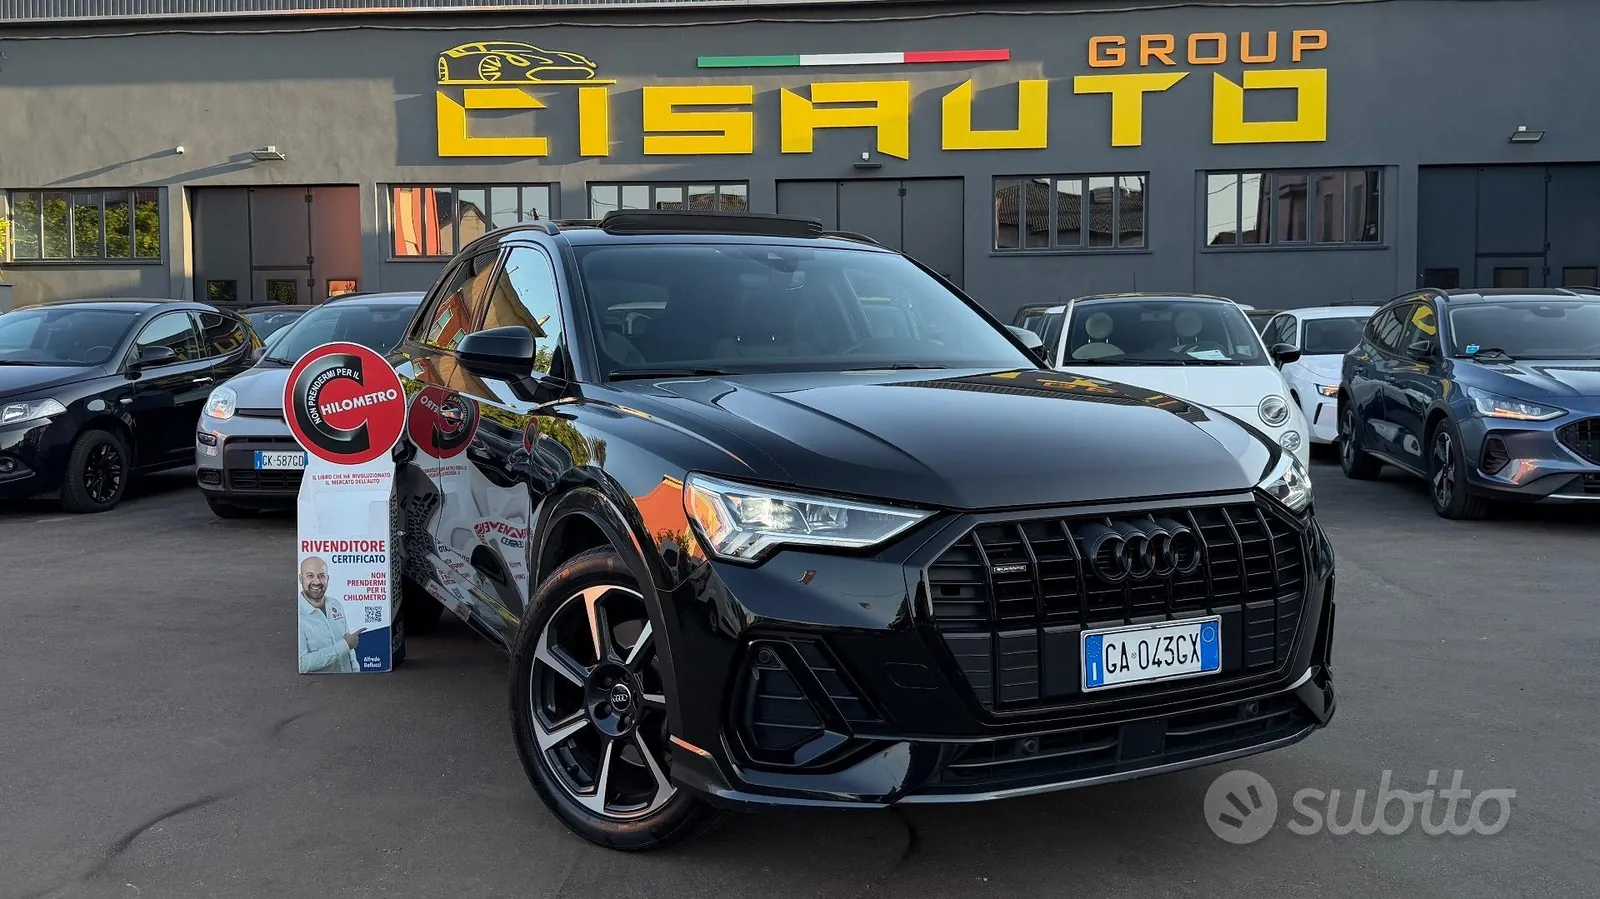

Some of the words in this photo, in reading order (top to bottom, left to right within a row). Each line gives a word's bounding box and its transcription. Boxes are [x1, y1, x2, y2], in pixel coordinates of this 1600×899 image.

[1089, 29, 1329, 68] GROUP
[437, 68, 1327, 160] CISAUTO
[336, 368, 353, 376] PER
[353, 371, 360, 380] IL
[308, 369, 336, 406] PRENDERMI
[308, 407, 322, 425] NON
[301, 540, 386, 552] RIVENDITORE
[331, 554, 386, 564] CERTIFICATO
